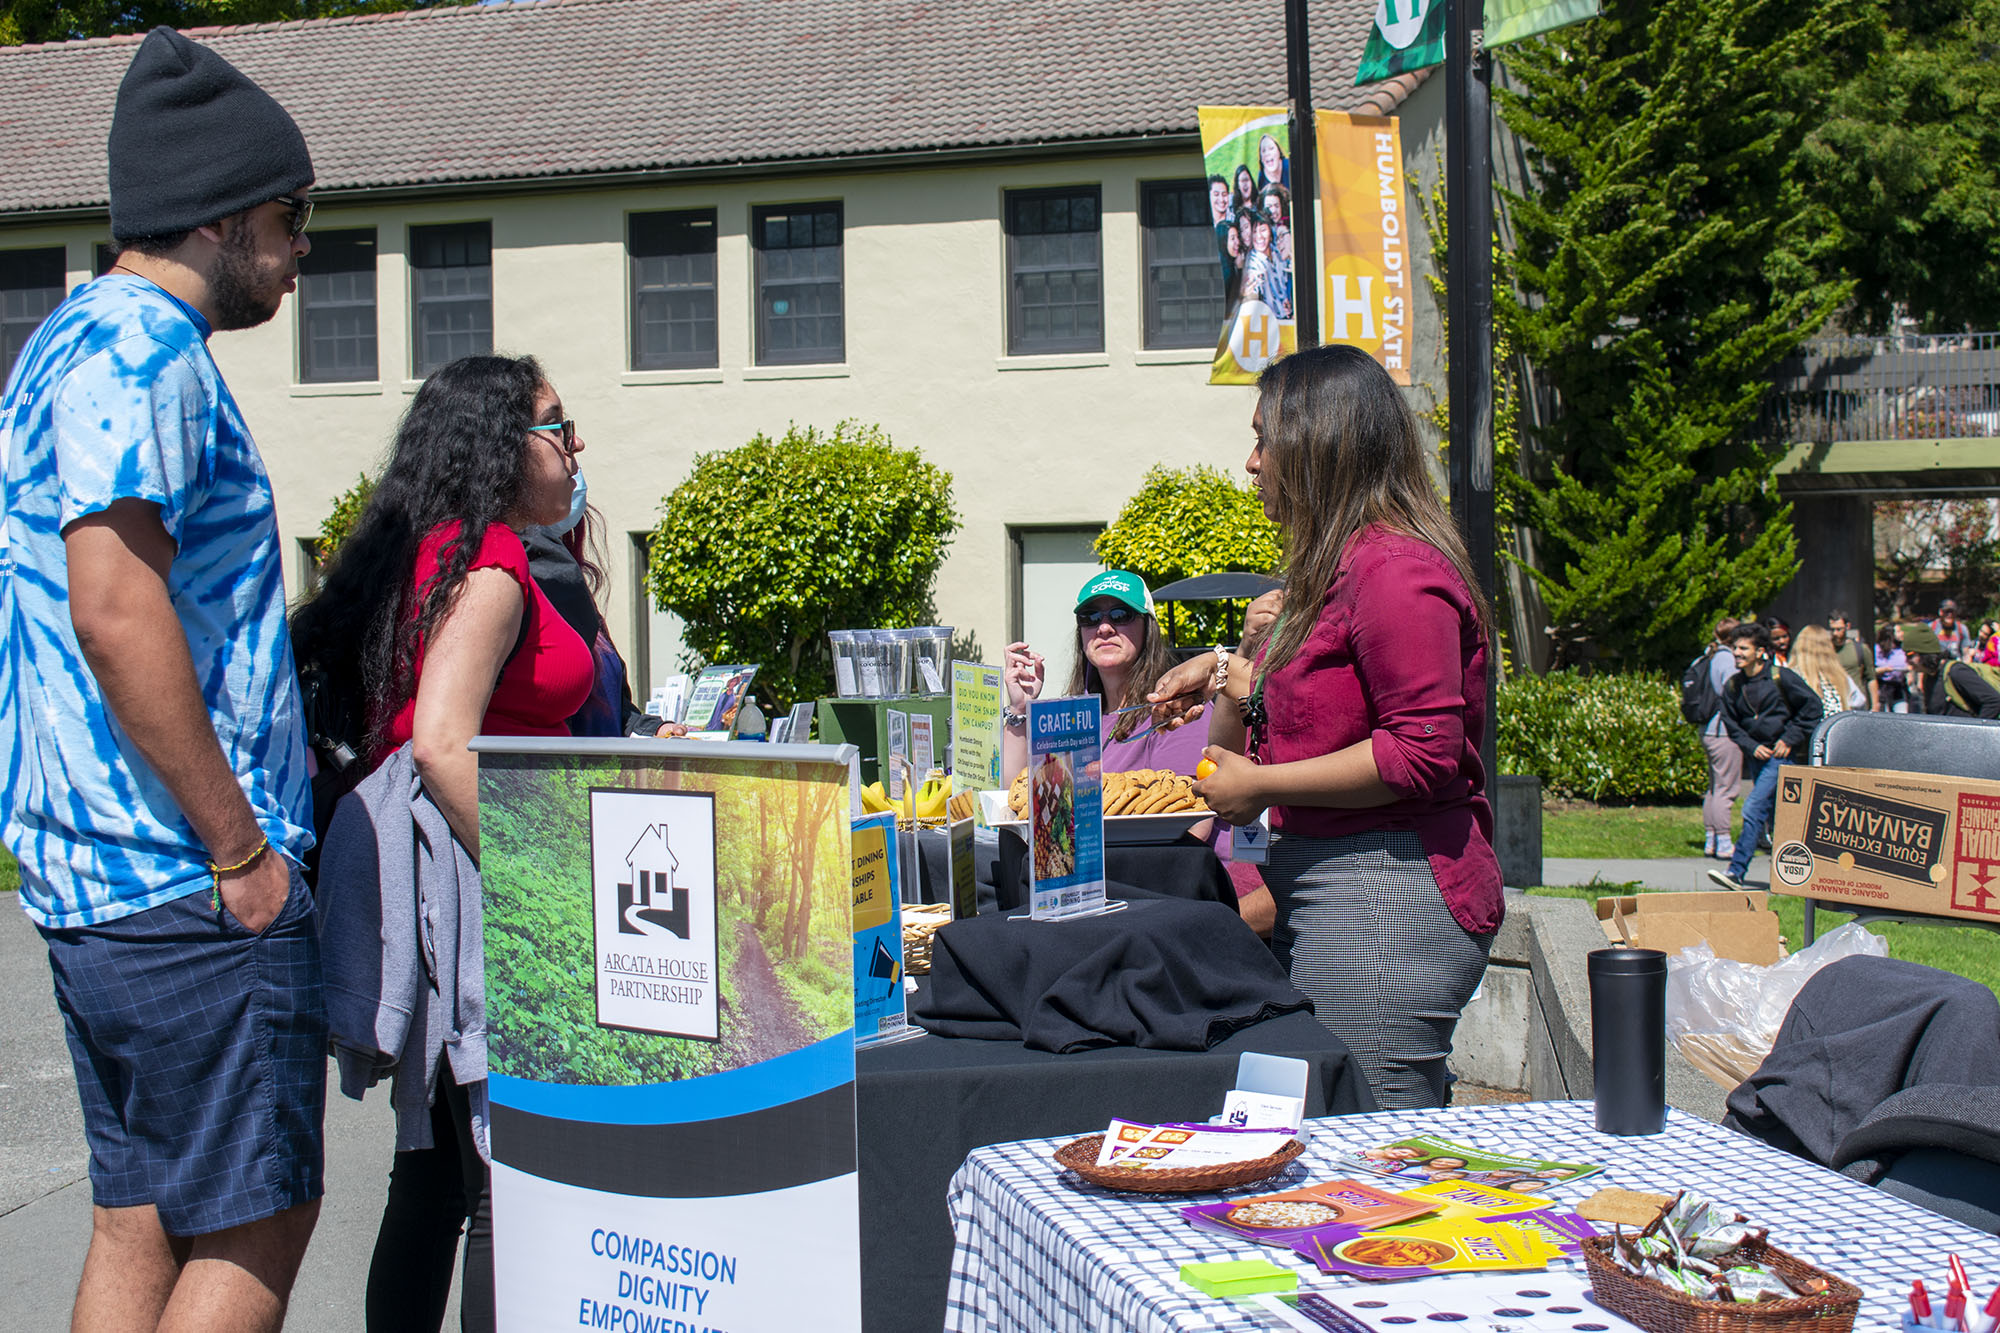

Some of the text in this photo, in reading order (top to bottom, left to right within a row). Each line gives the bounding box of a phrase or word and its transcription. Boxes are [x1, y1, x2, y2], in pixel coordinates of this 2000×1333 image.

[1375, 133, 1404, 370] HUMBOLDT STATE
[1330, 275, 1377, 339] H
[1241, 314, 1269, 358] H
[958, 687, 996, 702] DID YOU KNOW
[962, 717, 970, 726] ON
[1036, 741, 1058, 750] Celebrate
[1058, 739, 1069, 748] Earth
[1070, 738, 1078, 748] Day
[1079, 736, 1088, 745] with
[1962, 798, 1990, 806] TRADED
[1818, 801, 1934, 850] BANANAS
[1960, 806, 2000, 828] CHANGE
[1816, 825, 1927, 866] EQUAL EXCHANGE
[1960, 827, 2000, 861] QUAL
[858, 849, 883, 868] DINING
[1784, 864, 1804, 876] USDA
[1810, 884, 1889, 900] ORGANIC BANANAS
[1818, 878, 1882, 891] PRODUCT OF ECUADOR
[604, 953, 709, 980] ARCATA HOUSE
[610, 979, 703, 1006] PARTNERSHIP
[1325, 1190, 1391, 1208] SPICY
[1436, 1188, 1523, 1208] TANGY
[591, 1228, 736, 1285] COMPASSION
[1462, 1236, 1508, 1261] SWEET
[618, 1270, 709, 1315] DIGNITY
